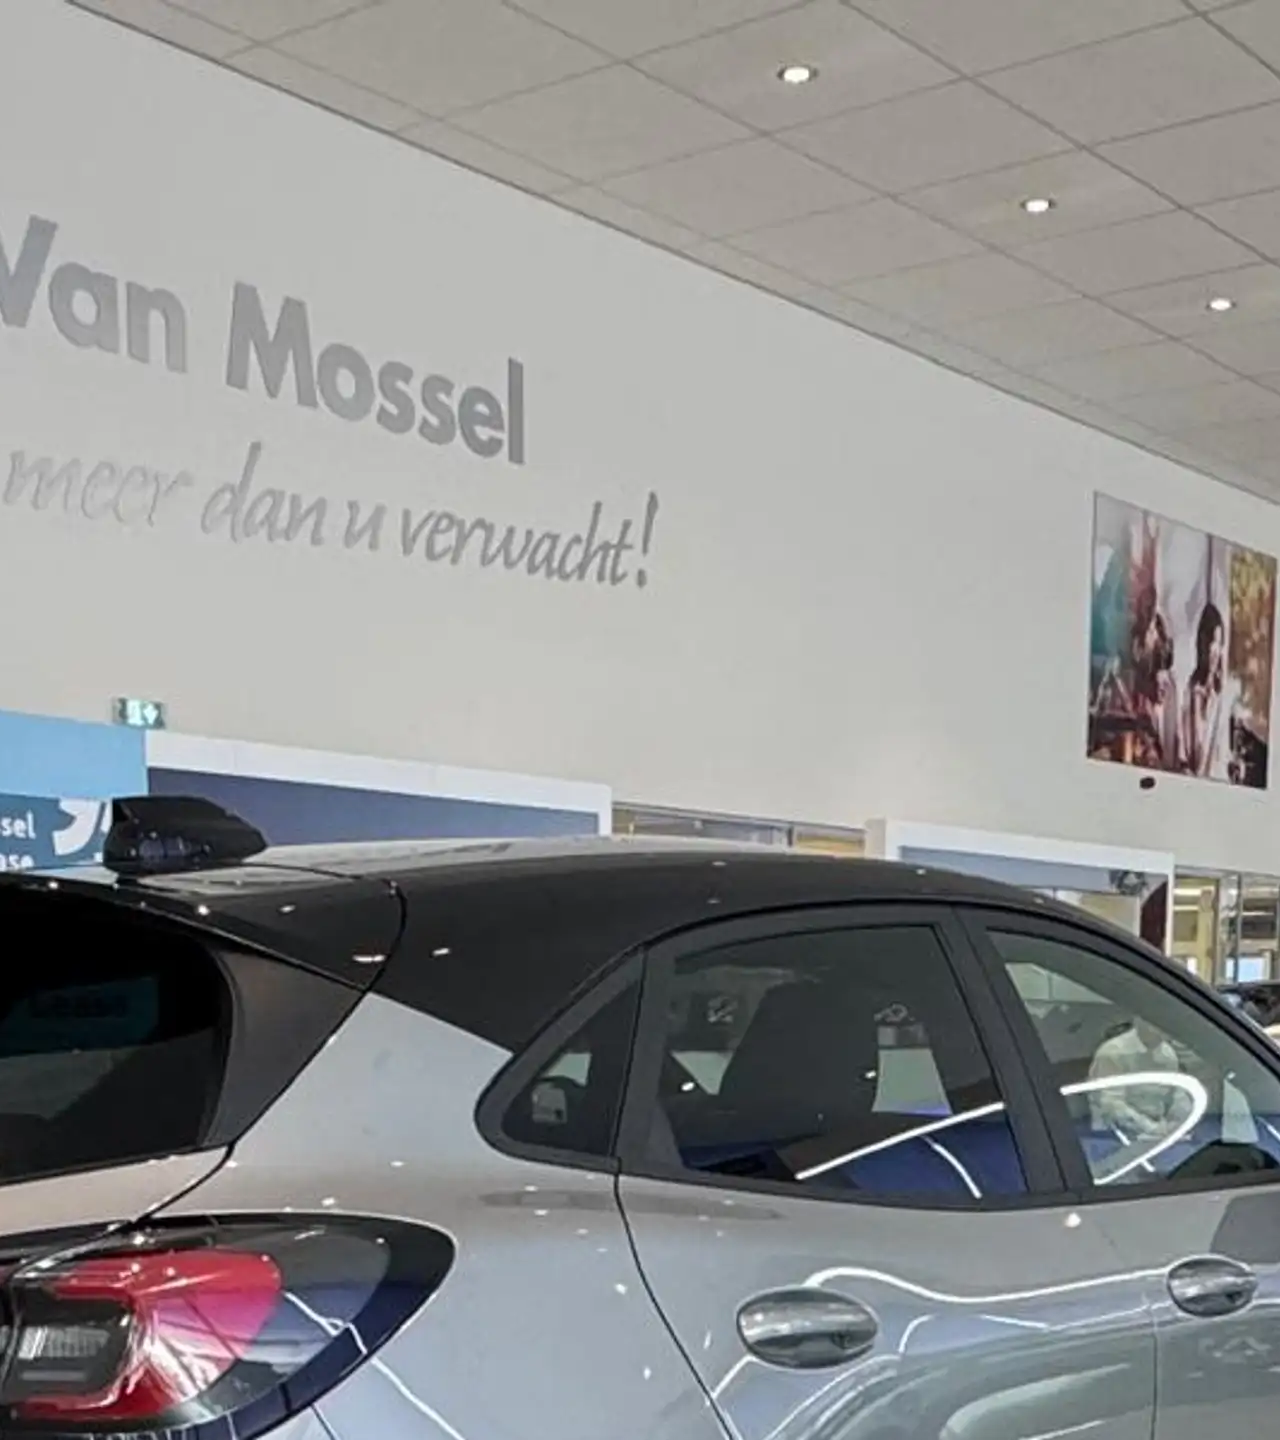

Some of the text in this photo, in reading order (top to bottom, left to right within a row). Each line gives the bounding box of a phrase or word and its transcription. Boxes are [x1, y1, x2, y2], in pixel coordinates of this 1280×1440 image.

[226, 280, 525, 466] Mossel
[3, 450, 194, 528] meer
[200, 441, 327, 547] dan
[344, 500, 386, 551] u
[401, 491, 659, 588] verwacht!
